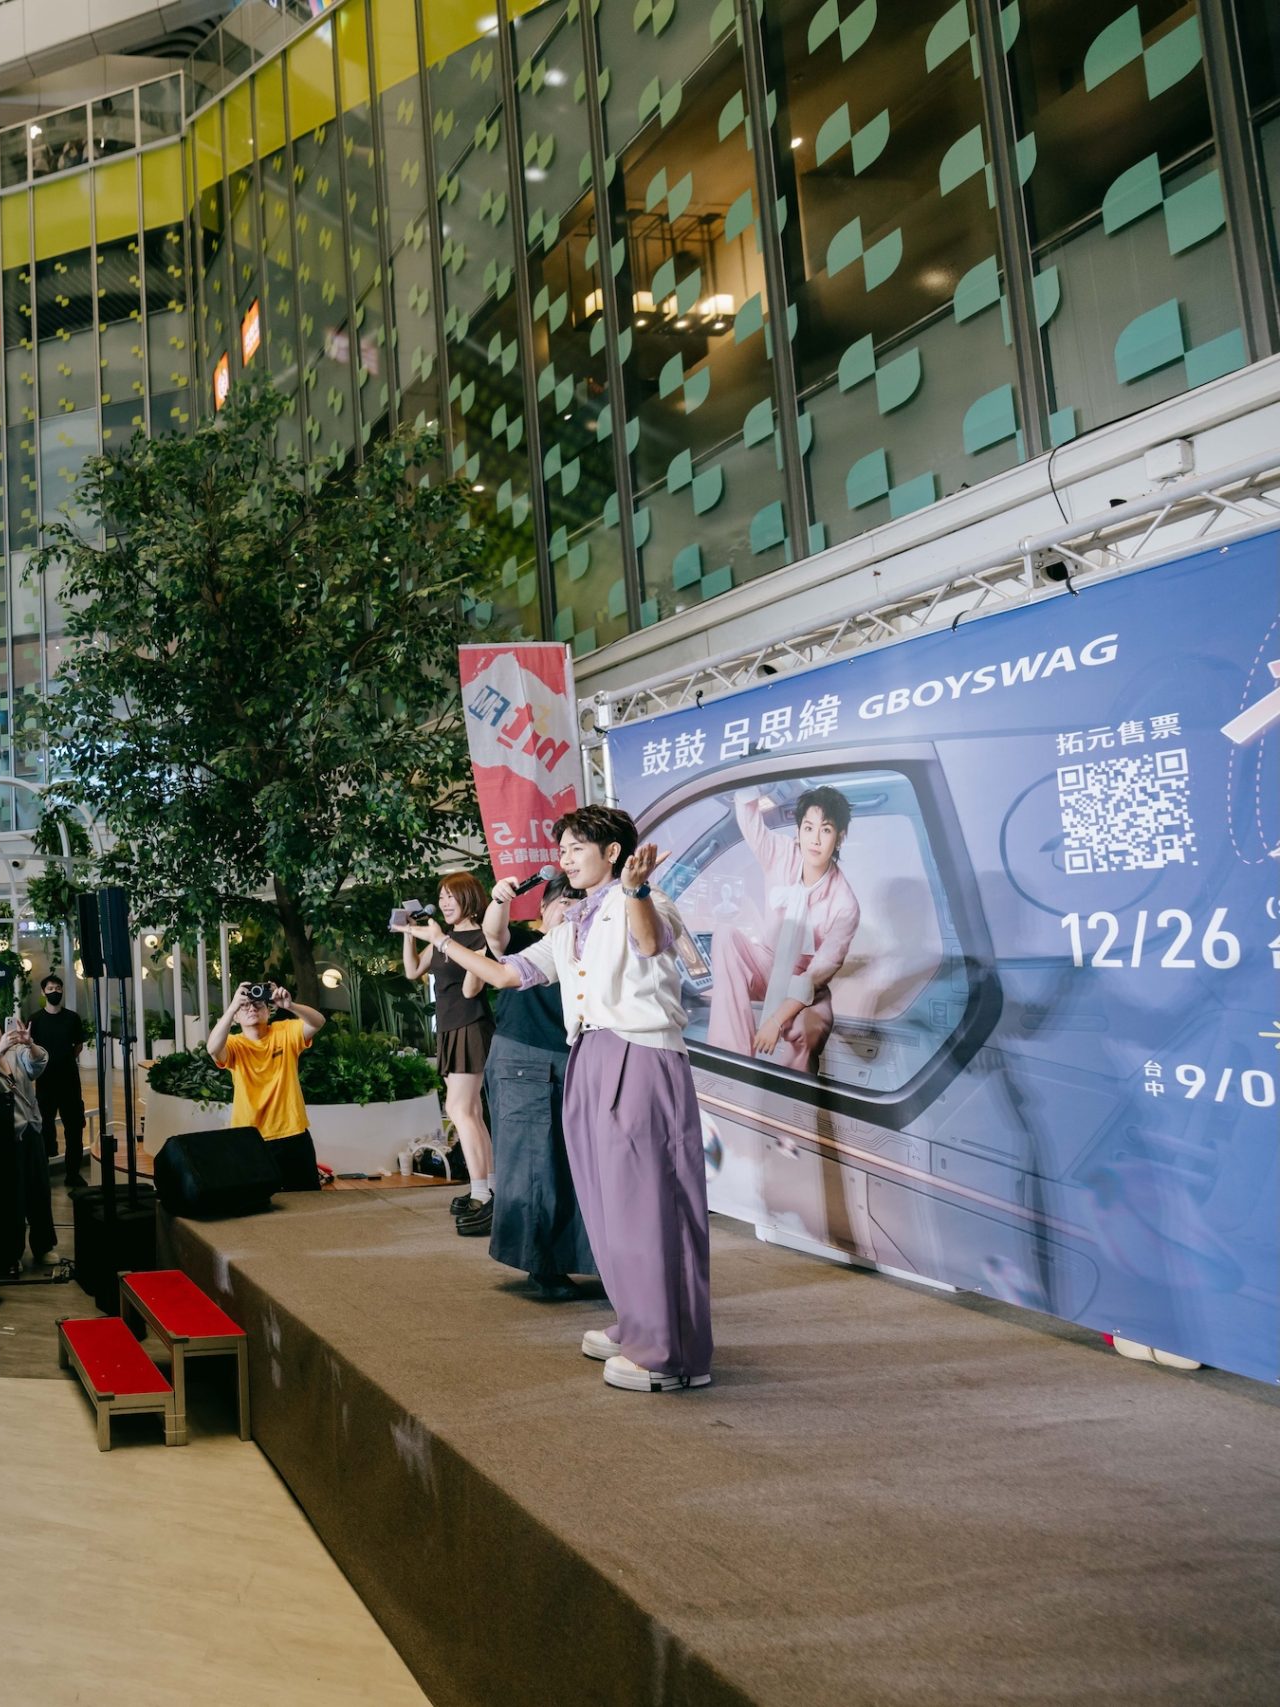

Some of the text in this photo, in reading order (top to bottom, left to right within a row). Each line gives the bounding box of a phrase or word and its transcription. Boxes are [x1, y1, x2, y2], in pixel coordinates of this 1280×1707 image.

[641, 633, 1119, 778] 鼓鼓 呂思緯 GBOYSWAG
[1056, 712, 1181, 756] 拓元售票
[1061, 908, 1241, 969] 12/26
[1144, 1060, 1276, 1107] 台中 9/0
